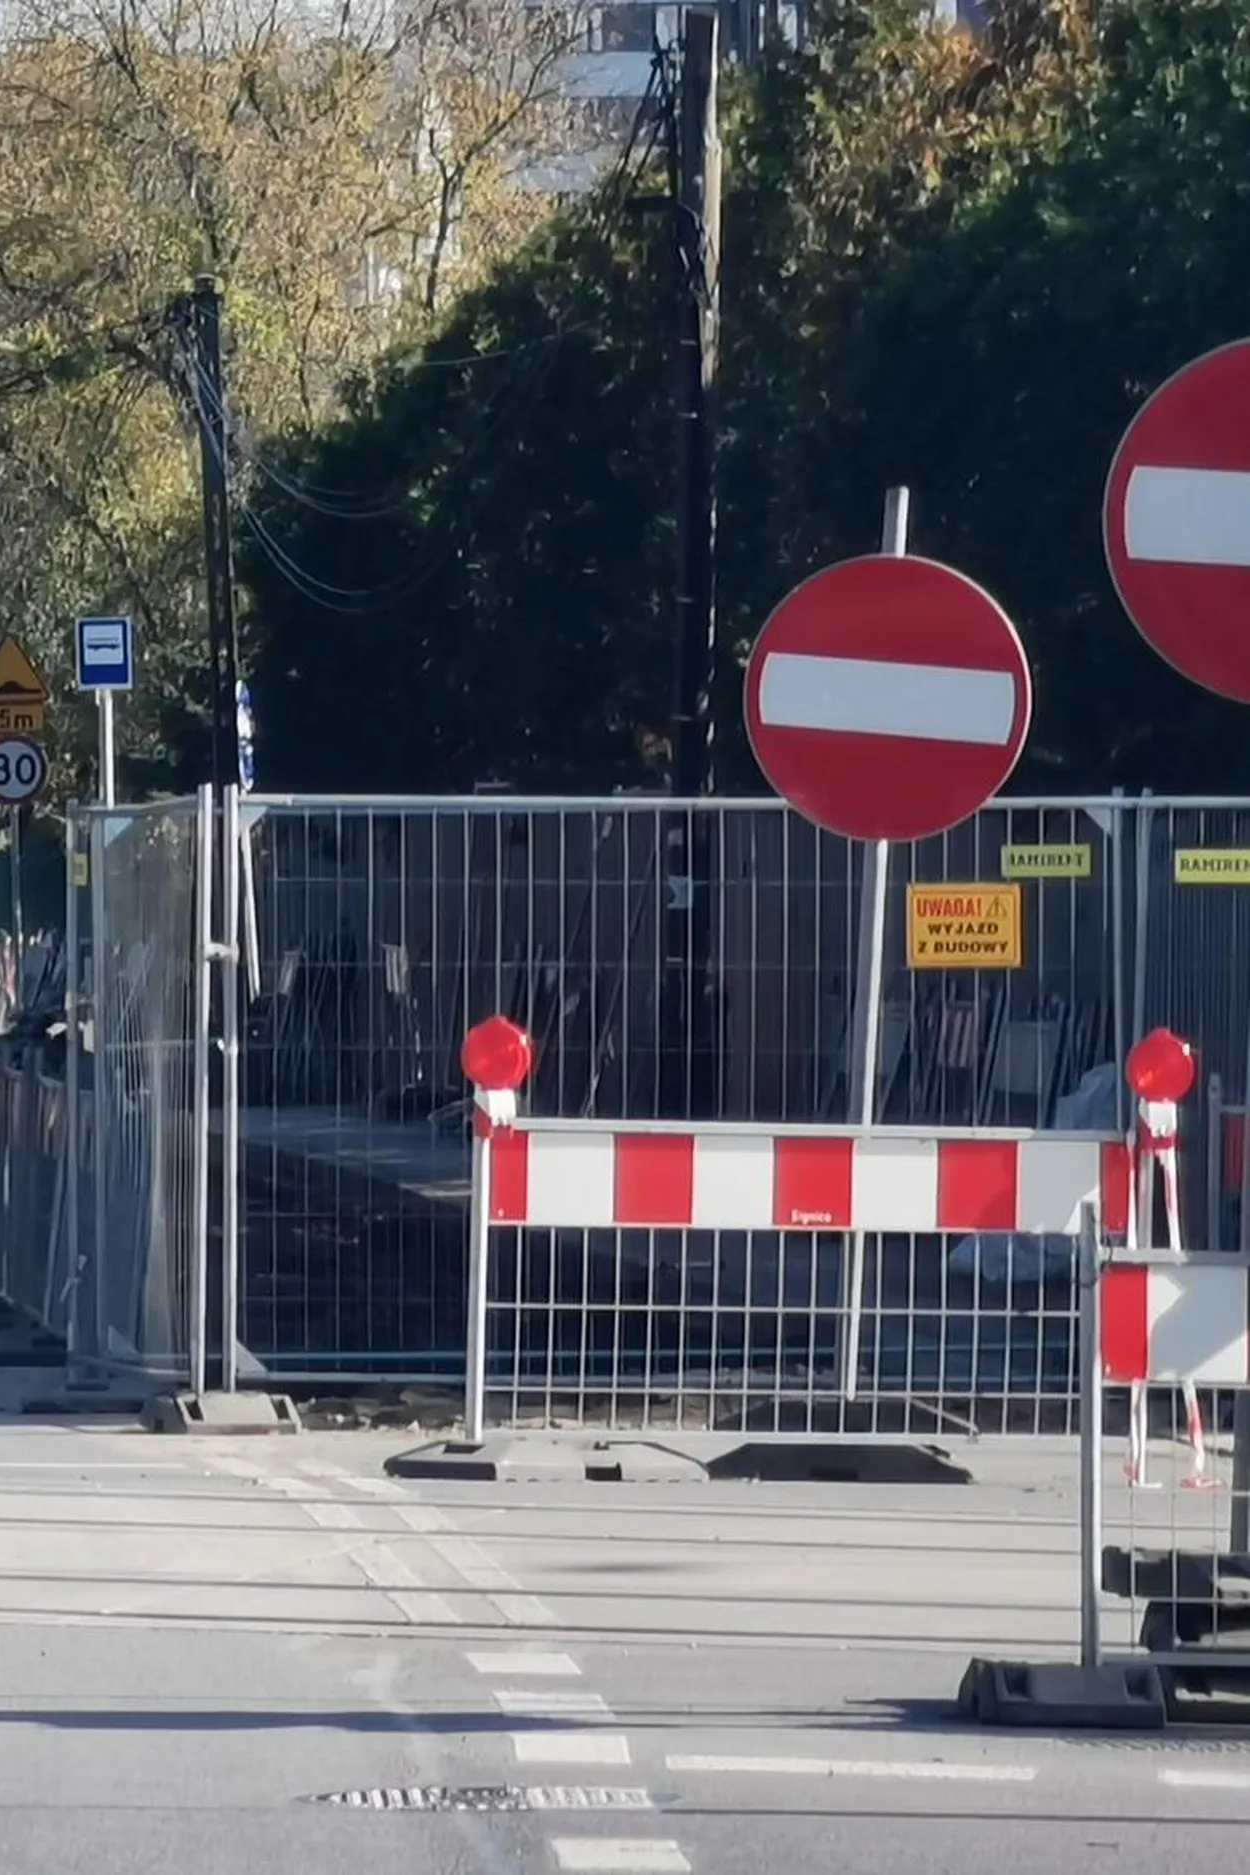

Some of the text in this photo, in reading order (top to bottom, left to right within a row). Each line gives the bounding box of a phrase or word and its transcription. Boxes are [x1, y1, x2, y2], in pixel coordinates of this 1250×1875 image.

[927, 922, 1000, 936] WYJAZD
[918, 941, 1009, 954] Z BUDOWY
